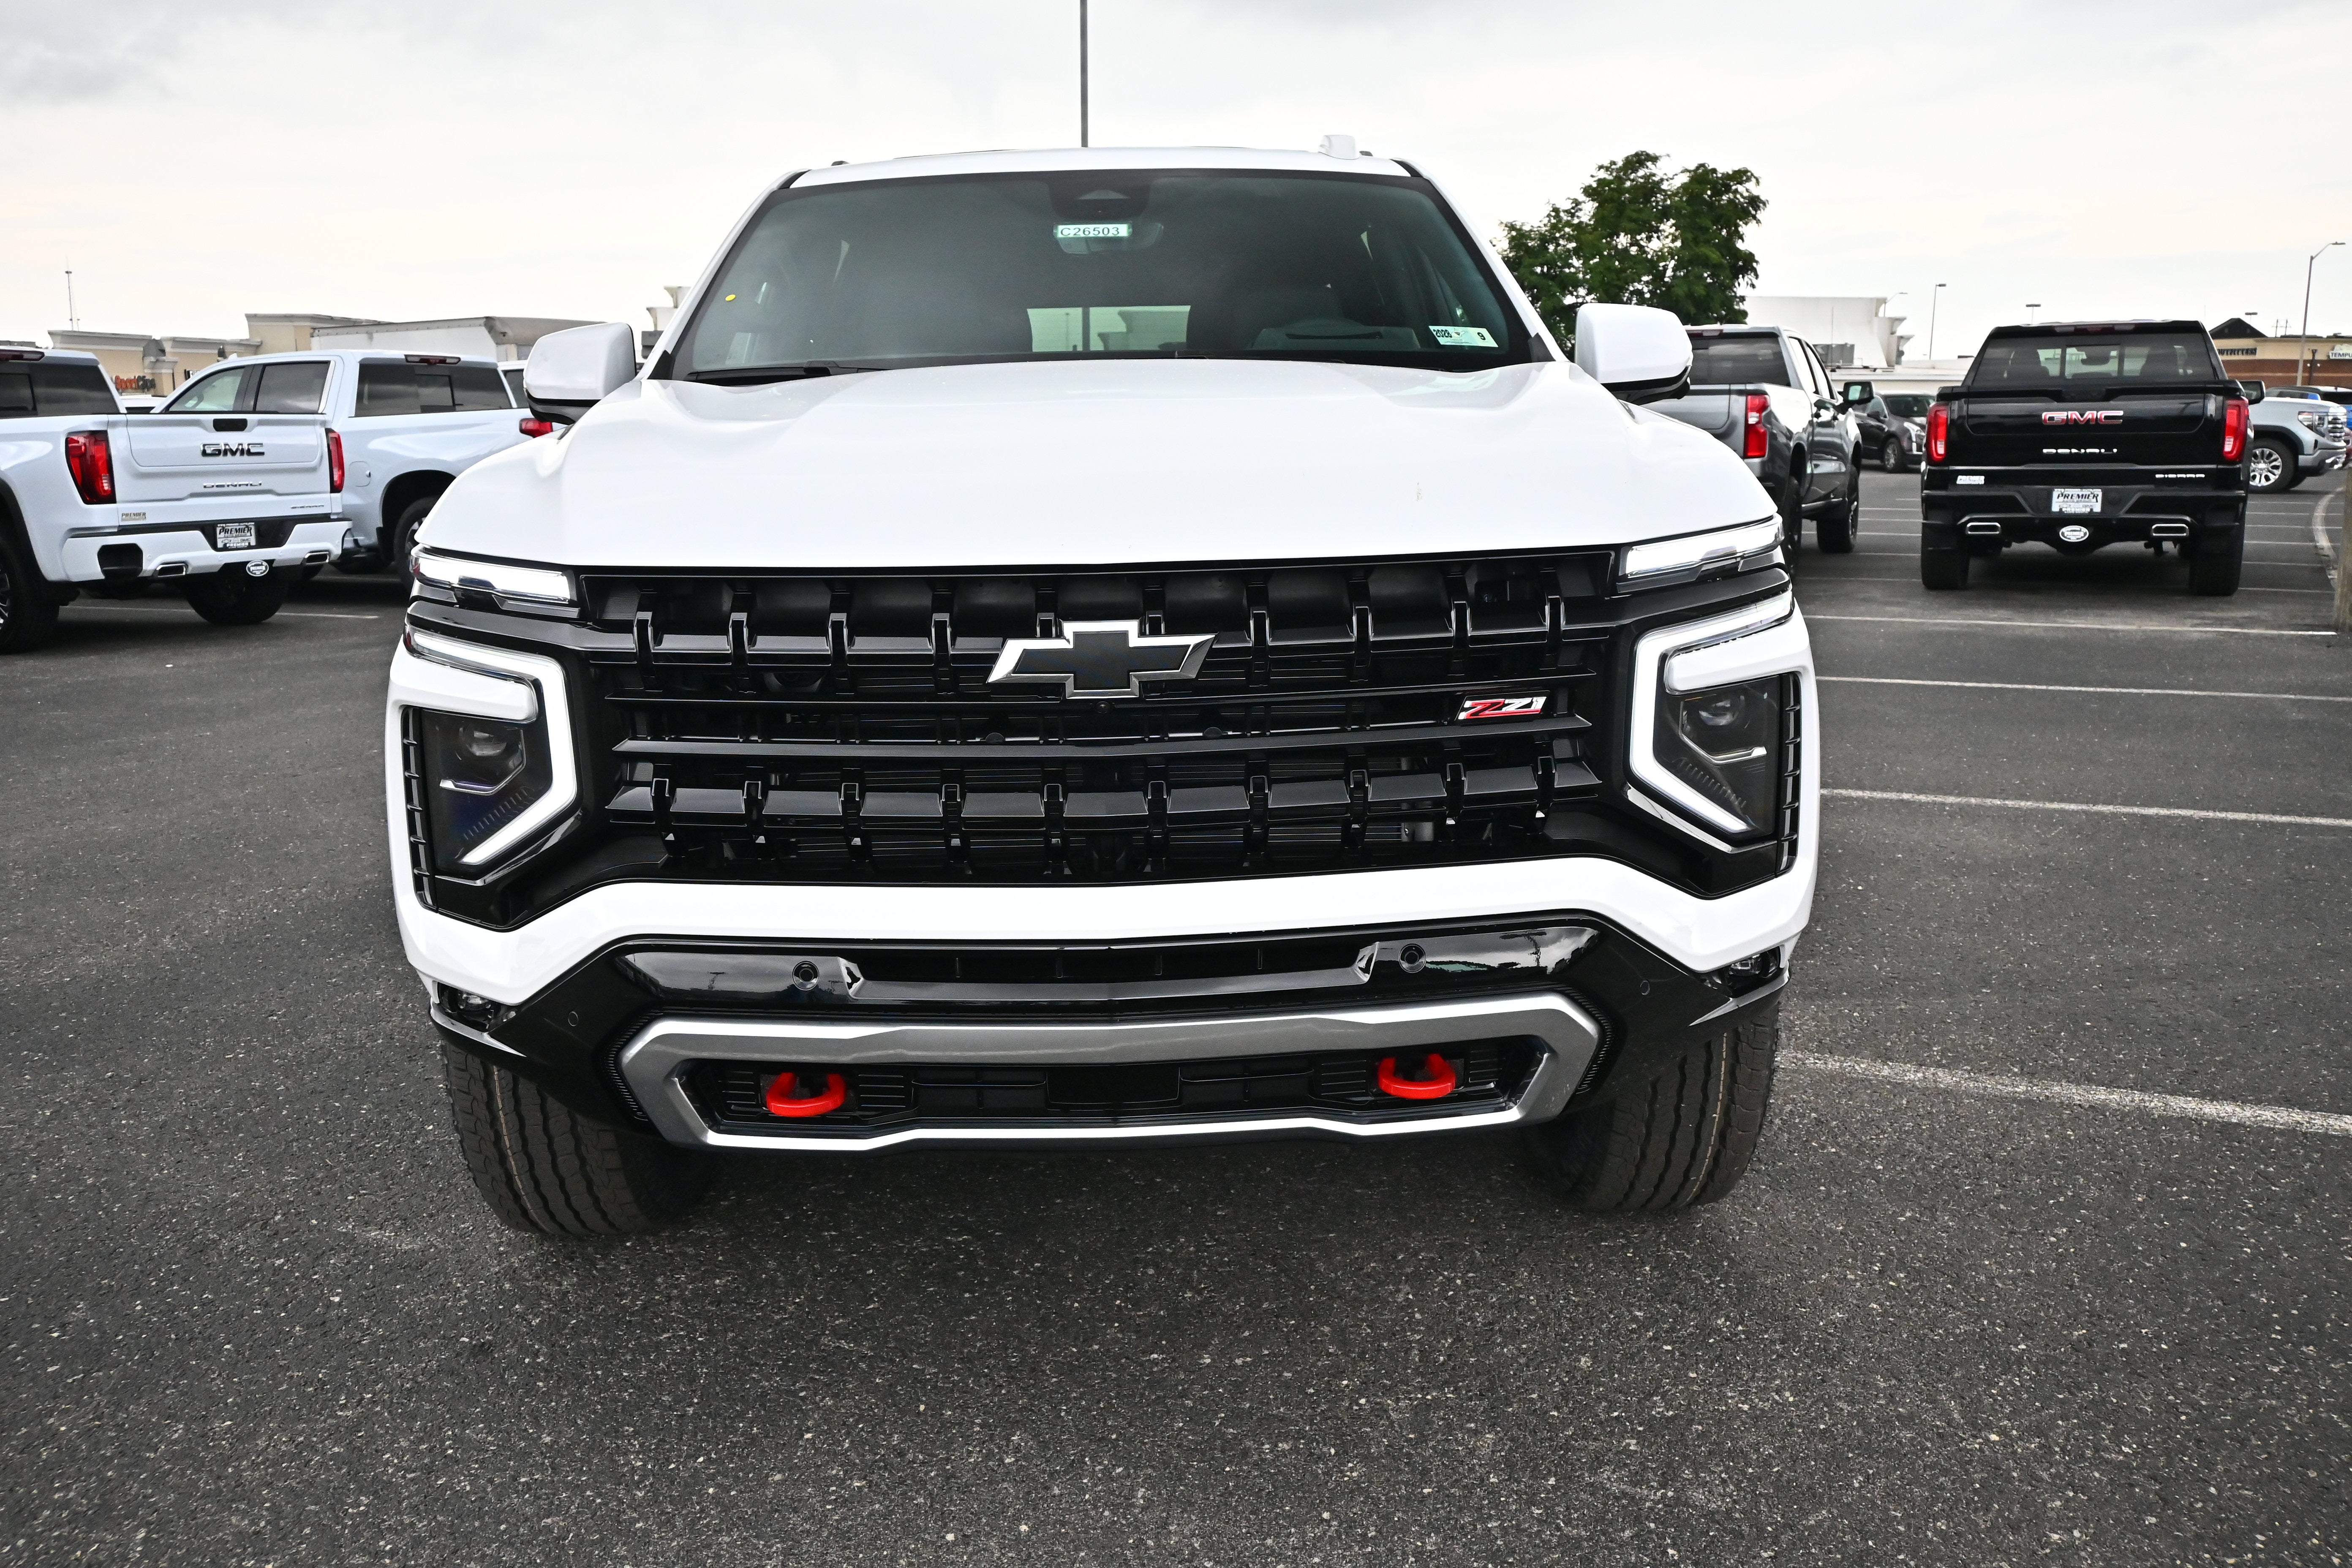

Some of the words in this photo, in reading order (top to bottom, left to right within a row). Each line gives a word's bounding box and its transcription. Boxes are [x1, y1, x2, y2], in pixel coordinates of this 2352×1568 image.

[1060, 227, 1120, 236] C26503
[1433, 329, 1452, 338] 2028
[1477, 332, 1486, 340] 9
[2042, 411, 2123, 425] GMC
[201, 443, 265, 457] GMC
[2057, 493, 2099, 503] PREMIER
[219, 526, 252, 536] PREMIER
[1458, 697, 1547, 719] Z71
